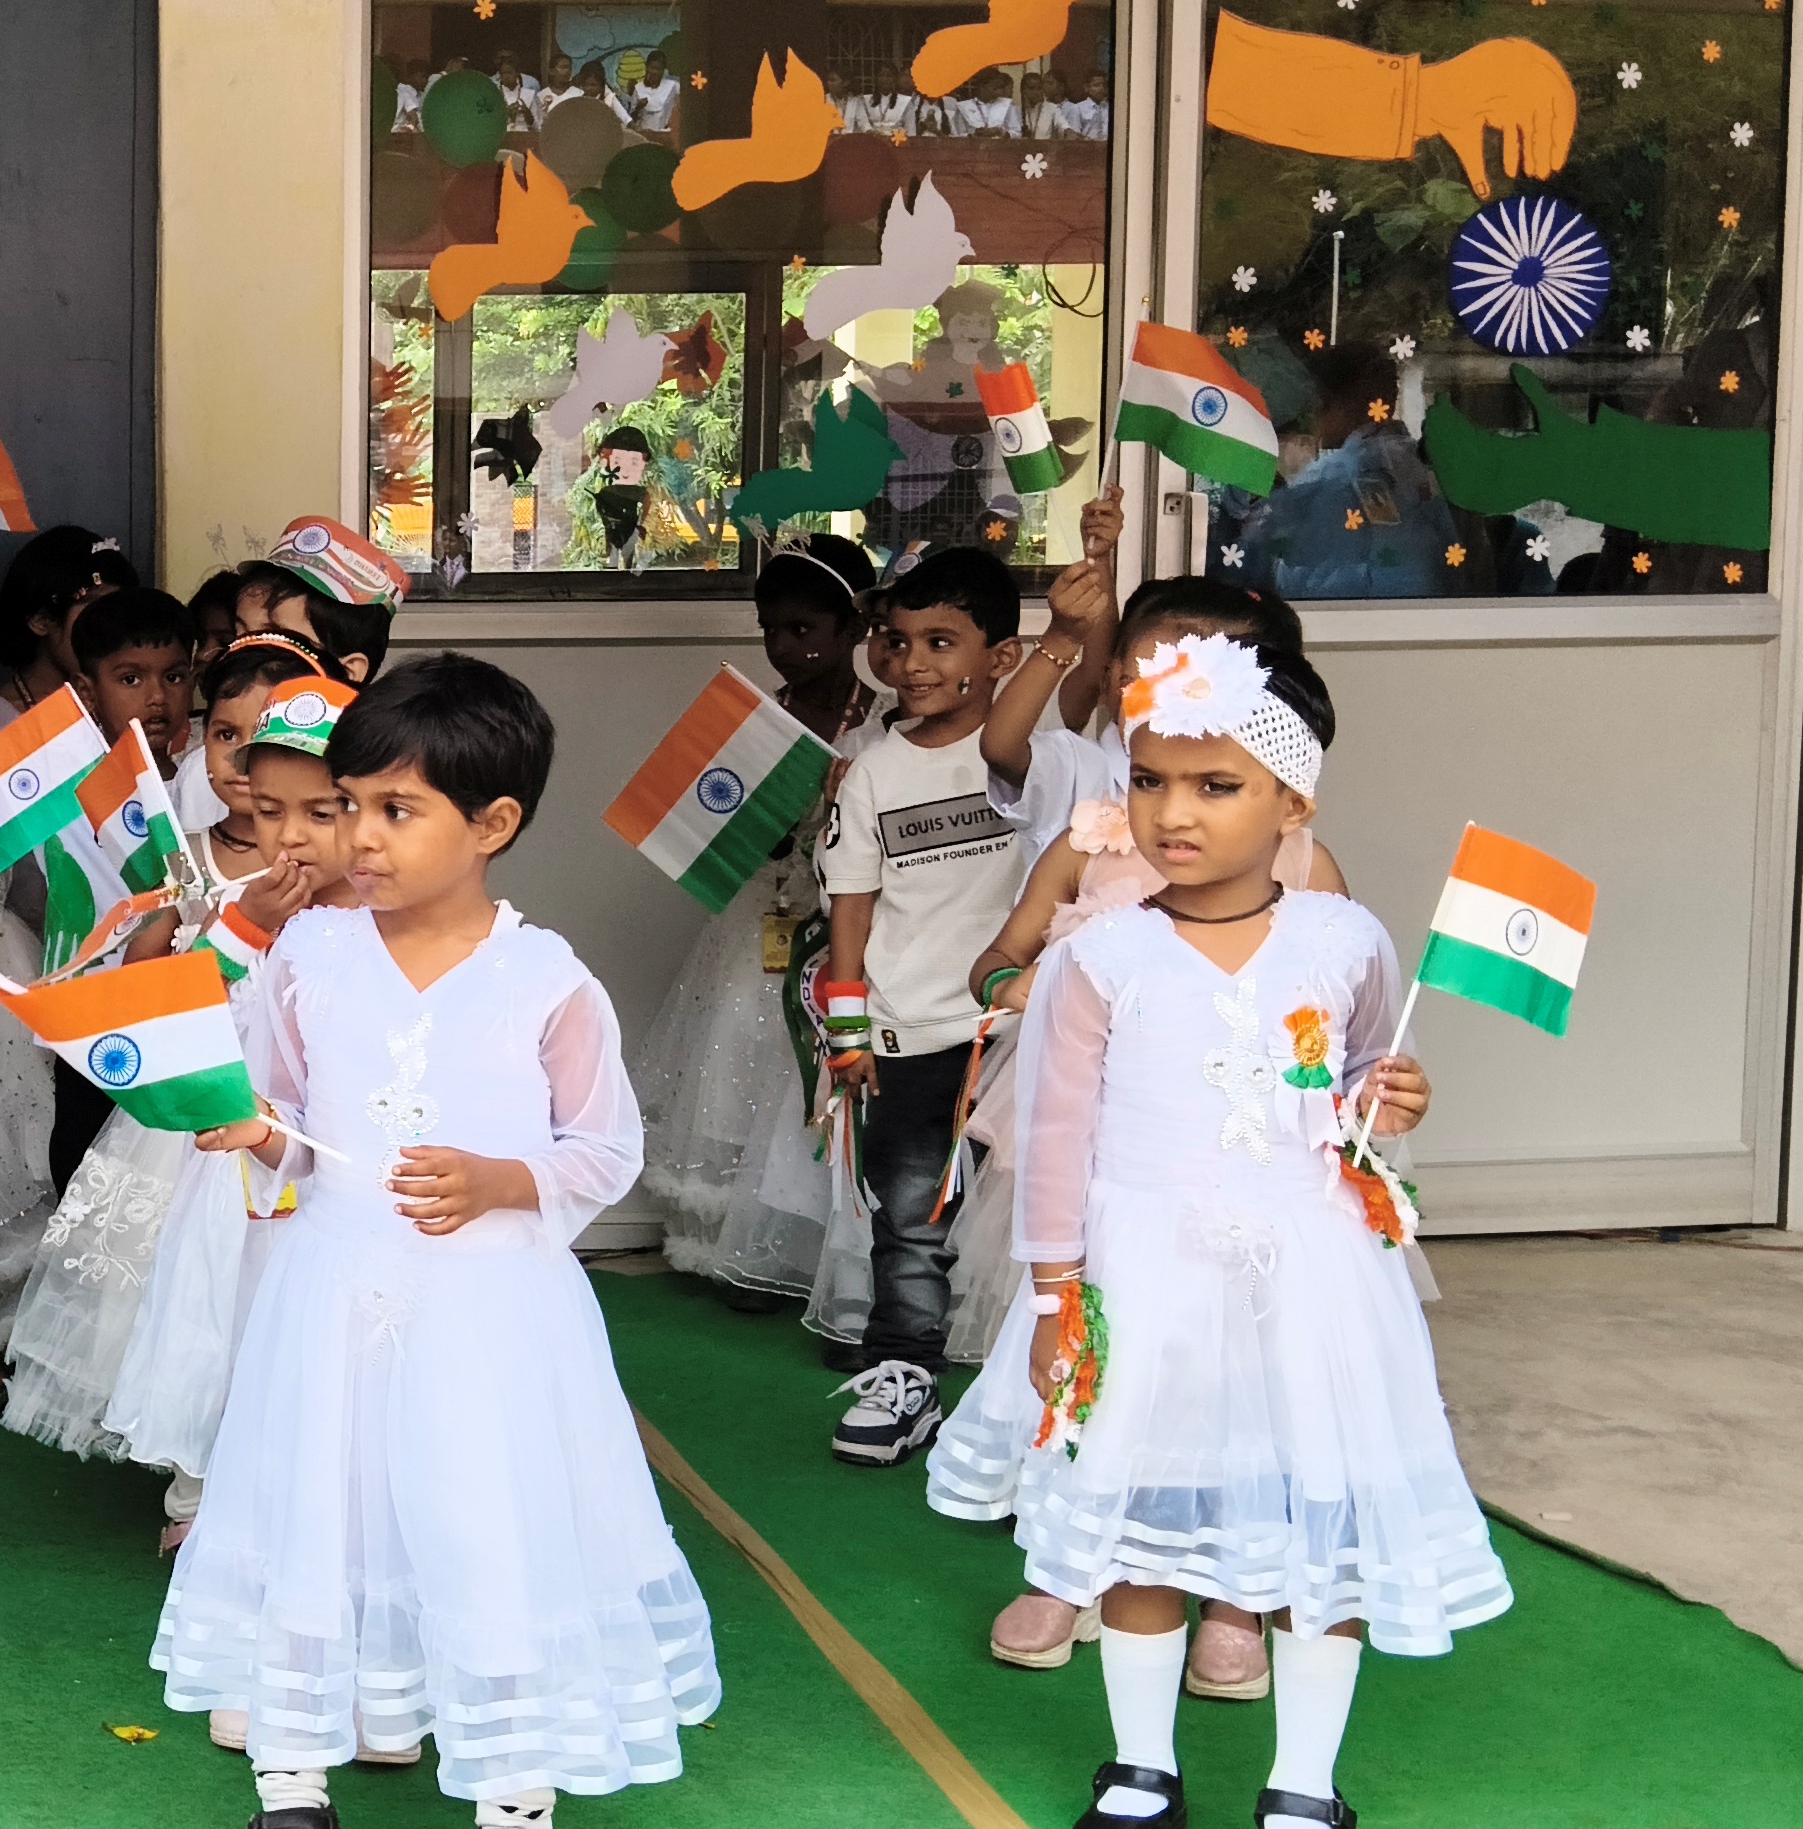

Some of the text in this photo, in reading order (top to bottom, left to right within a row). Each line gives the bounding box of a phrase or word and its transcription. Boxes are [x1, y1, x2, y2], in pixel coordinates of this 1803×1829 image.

[898, 817, 944, 838] LOUIS
[896, 853, 941, 869] MADISON
[943, 843, 994, 861] FOUNDER
